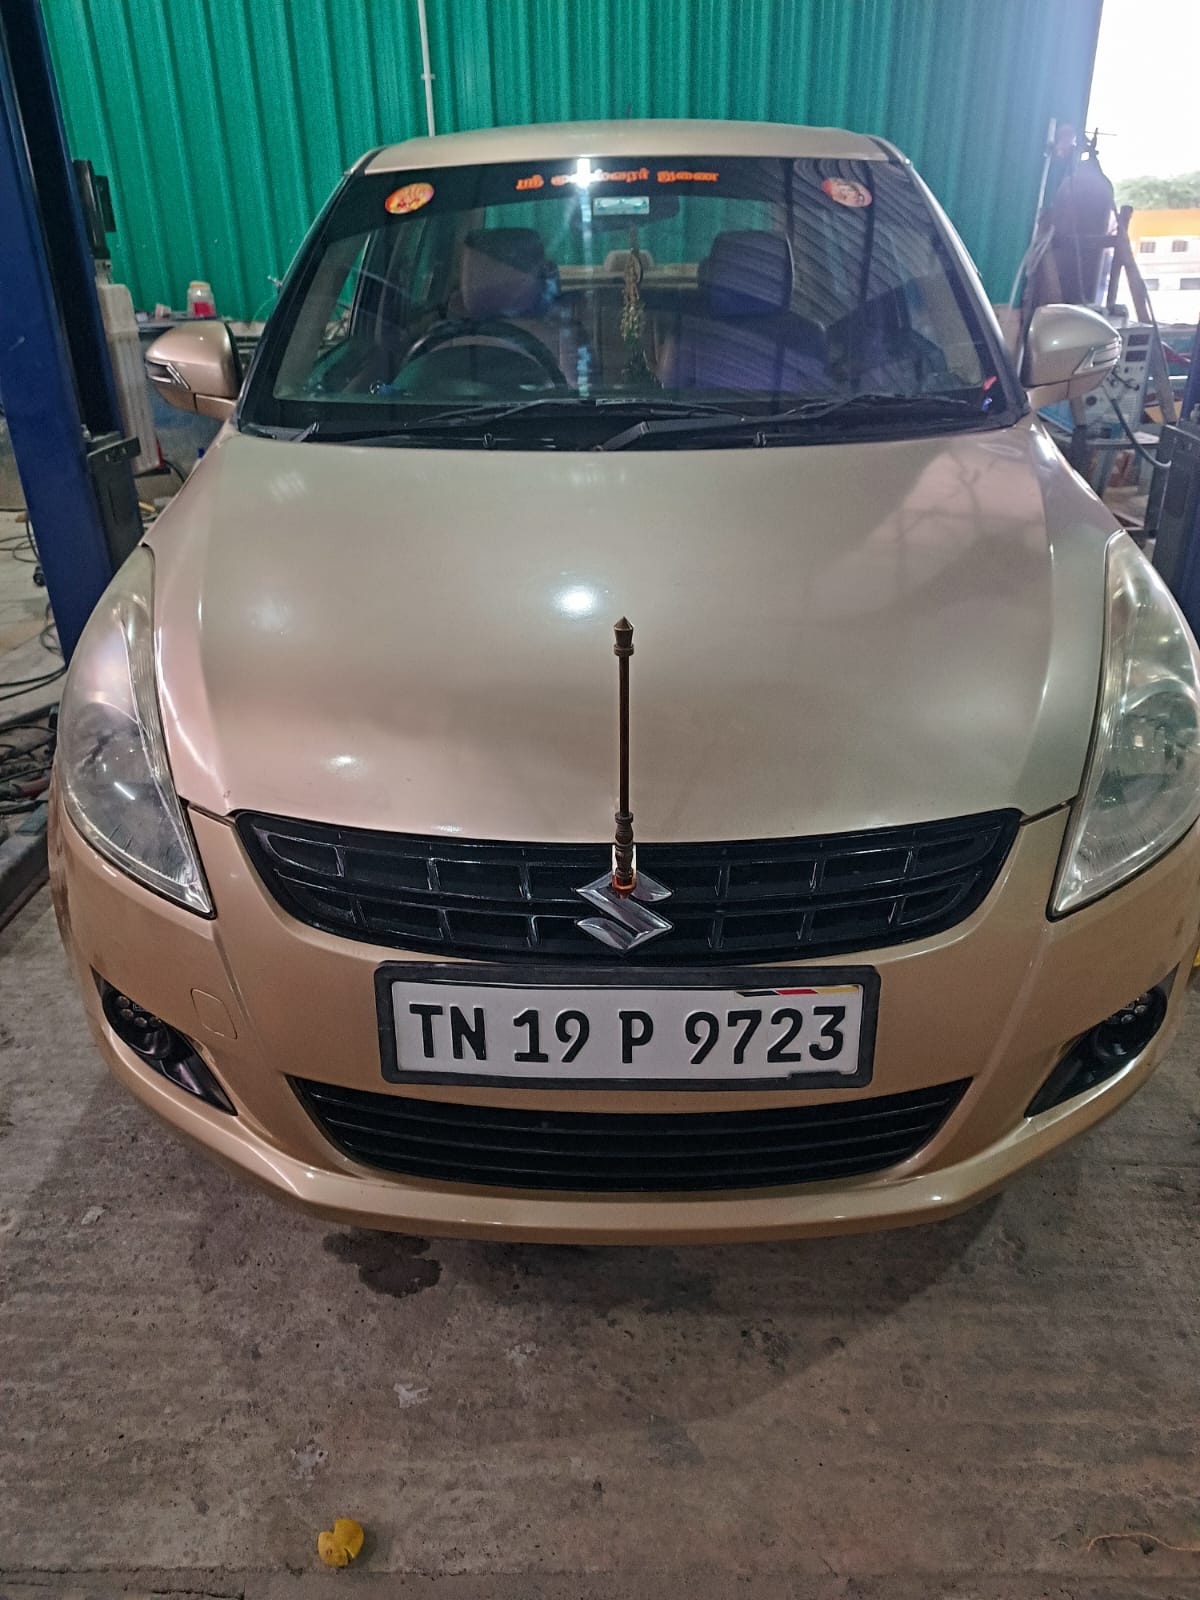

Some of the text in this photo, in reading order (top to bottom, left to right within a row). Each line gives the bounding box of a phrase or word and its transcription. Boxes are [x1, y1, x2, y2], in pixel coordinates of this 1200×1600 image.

[409, 1003, 846, 1064] TN 19 P 9723
